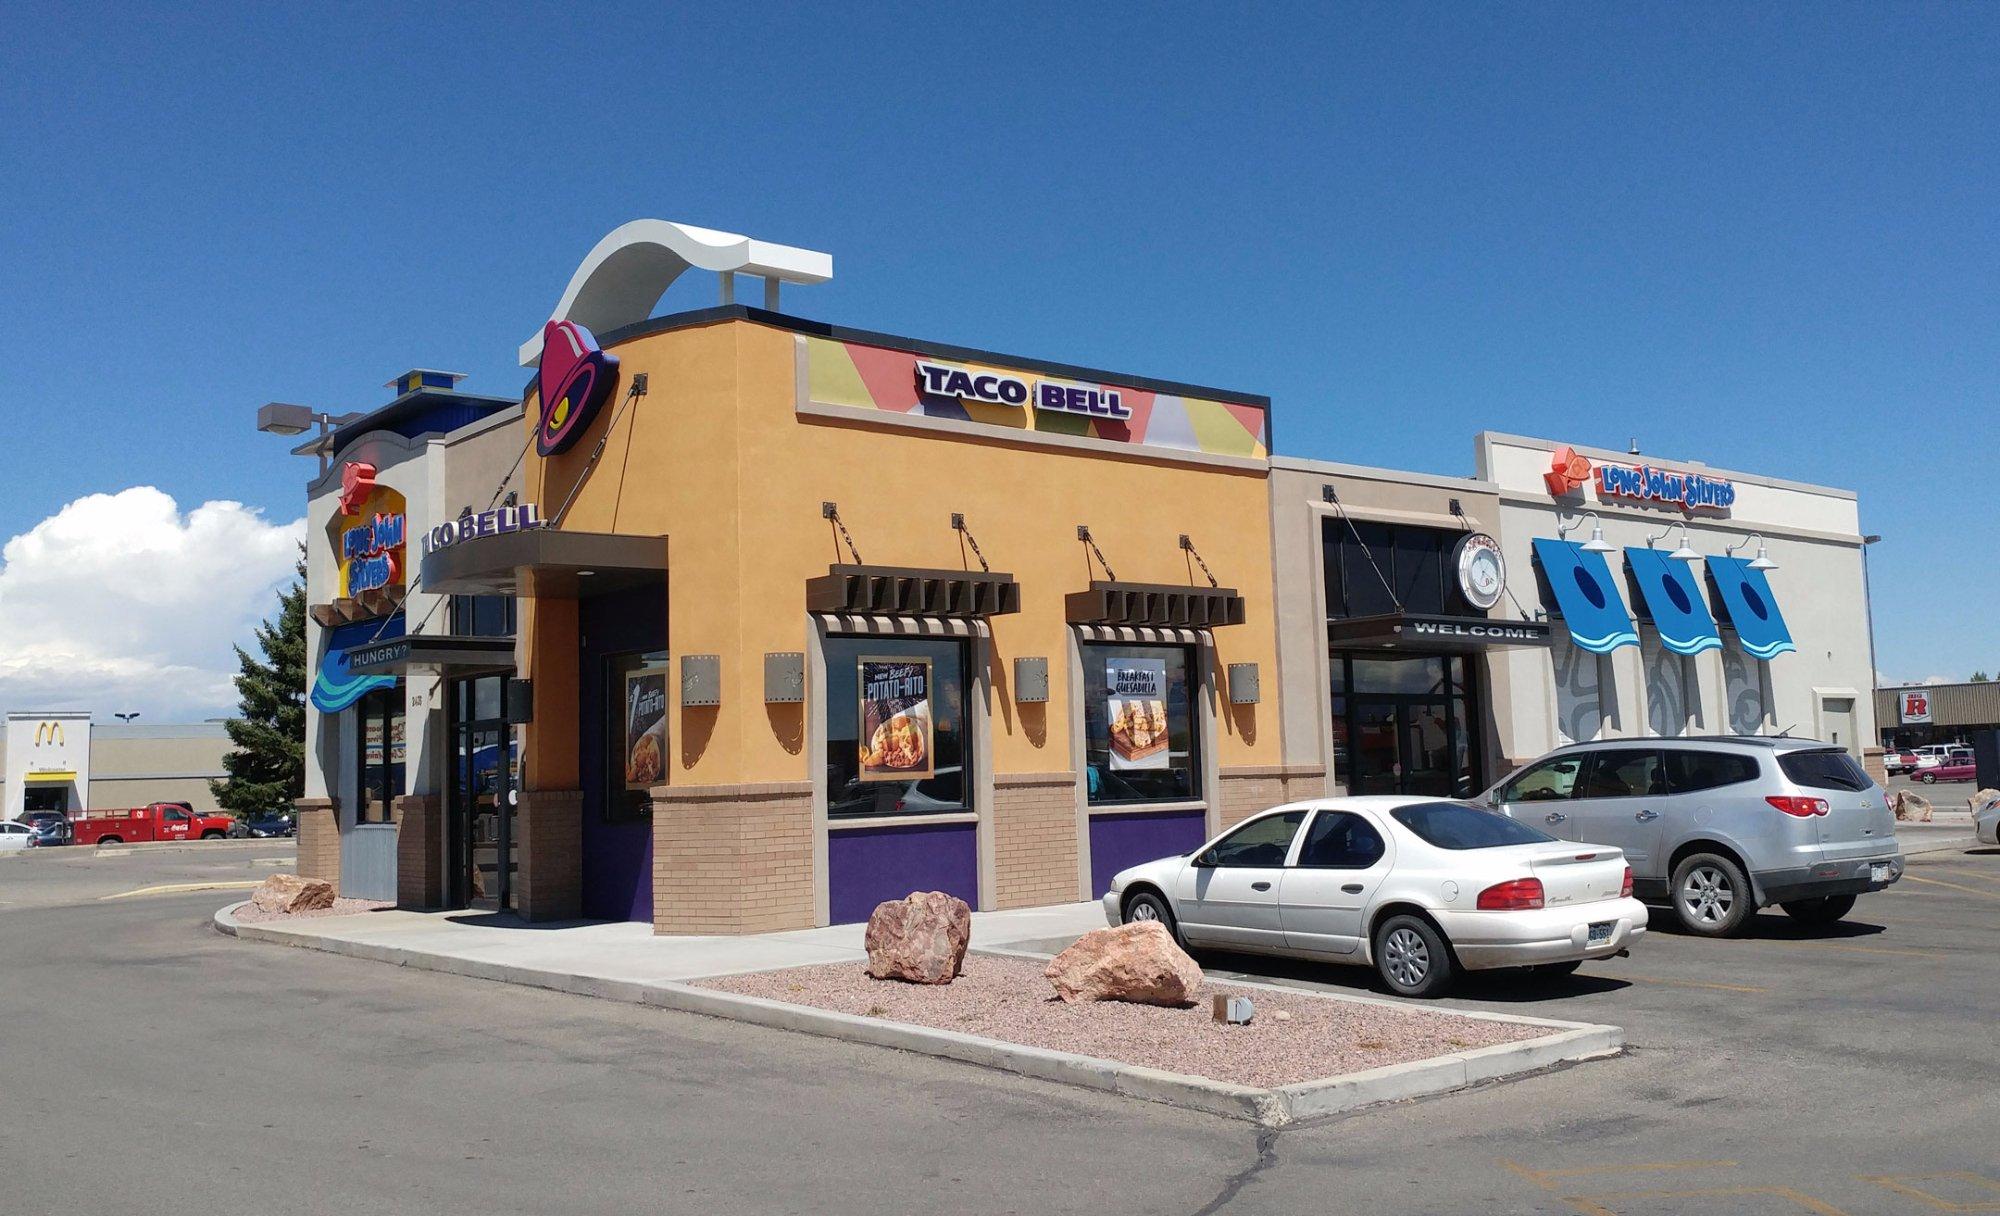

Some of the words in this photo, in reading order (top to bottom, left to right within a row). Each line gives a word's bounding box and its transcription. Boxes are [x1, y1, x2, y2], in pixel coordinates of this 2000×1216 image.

[919, 363, 1029, 404] TACO
[1040, 383, 1131, 418] BELL
[1601, 466, 1642, 496] LONG
[459, 503, 543, 542] BELL
[1414, 622, 1539, 639] WELCOME
[354, 645, 407, 667] HUNGRY?
[889, 666, 914, 680] BEEFY
[867, 675, 924, 702] POTATO-RITO
[1905, 698, 1927, 715] R
